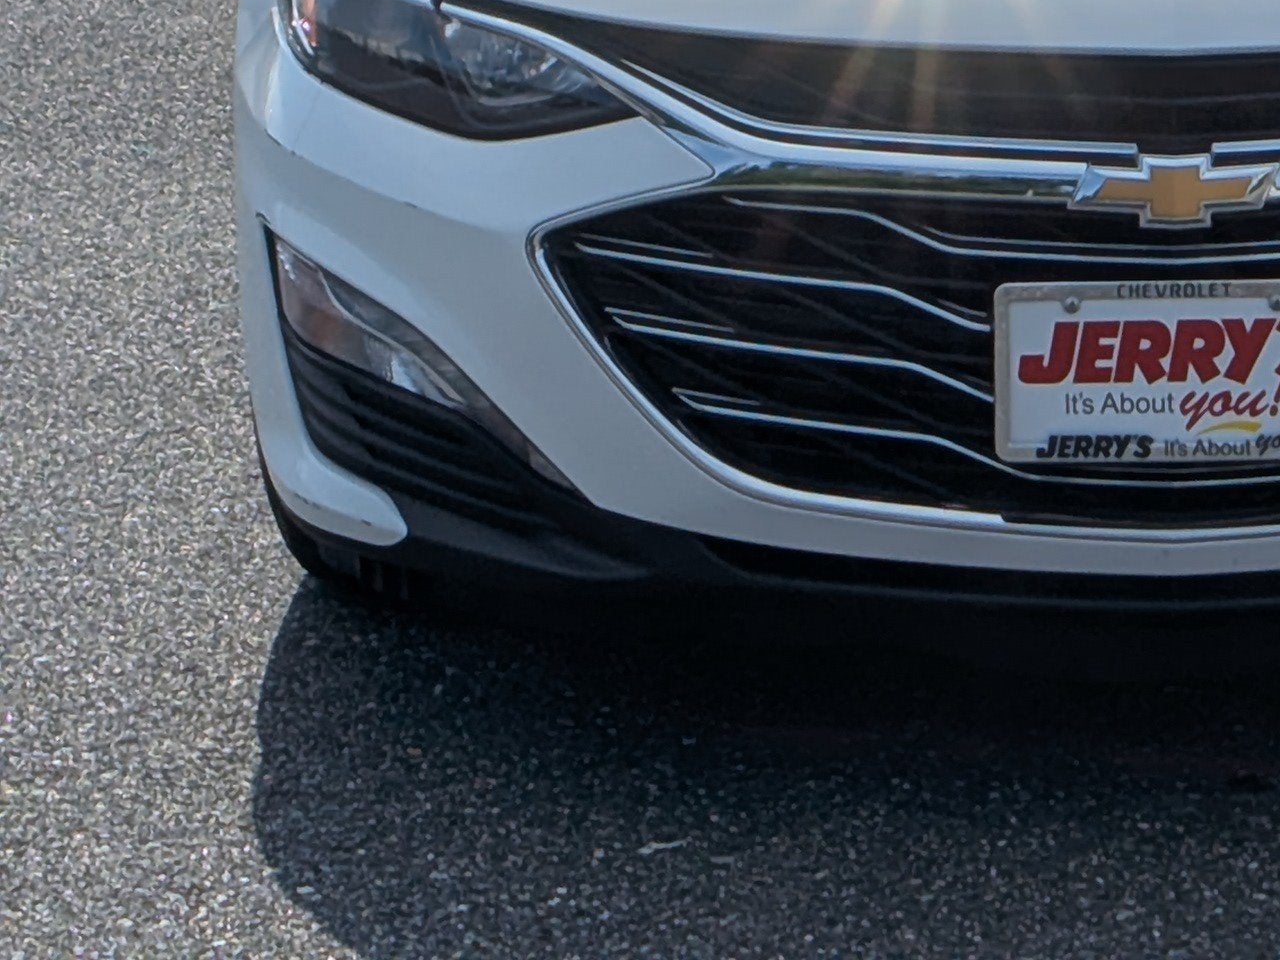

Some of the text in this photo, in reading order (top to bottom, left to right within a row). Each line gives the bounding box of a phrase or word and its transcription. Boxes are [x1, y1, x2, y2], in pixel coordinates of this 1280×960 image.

[1116, 282, 1232, 299] CHEVROLET
[1064, 392, 1096, 416] It's
[1100, 391, 1176, 416] About
[1036, 434, 1155, 459] JERRY'S
[1163, 438, 1189, 458] It's
[1192, 438, 1251, 458] About
